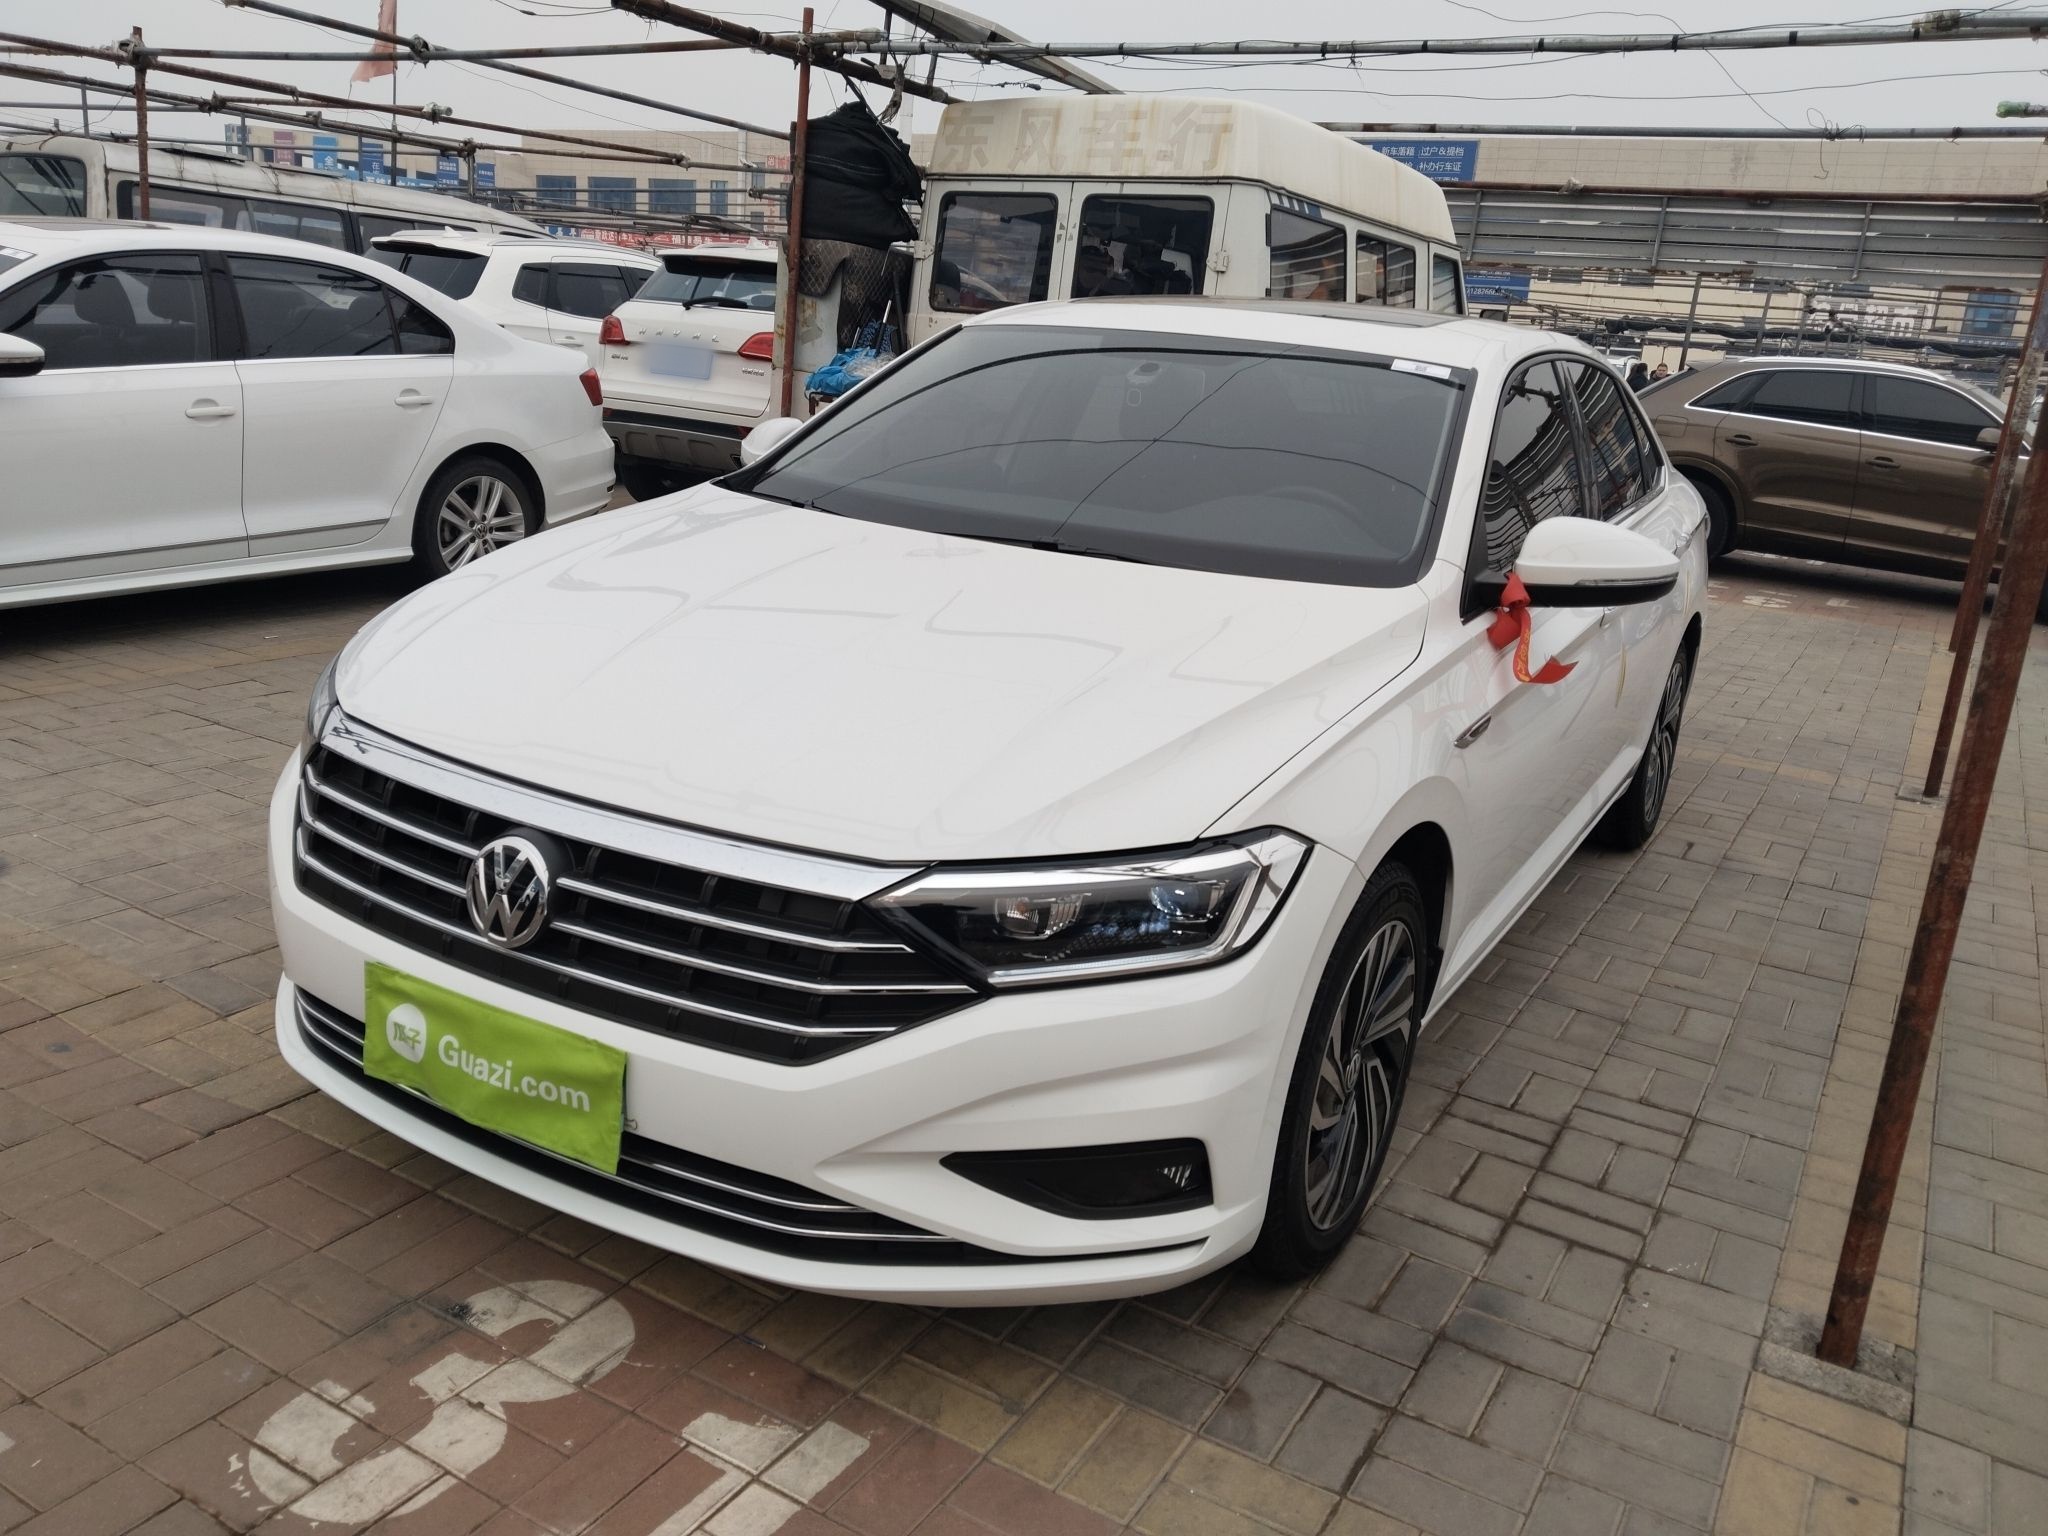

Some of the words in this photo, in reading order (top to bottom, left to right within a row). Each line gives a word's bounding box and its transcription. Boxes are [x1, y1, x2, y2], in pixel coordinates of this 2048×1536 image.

[939, 102, 1233, 172] 东风车行
[1420, 146, 1465, 157] 过户&提档
[1418, 161, 1462, 172] 补办行车证
[393, 1021, 421, 1050] 瓜子
[438, 1034, 590, 1112] Guazi.com
